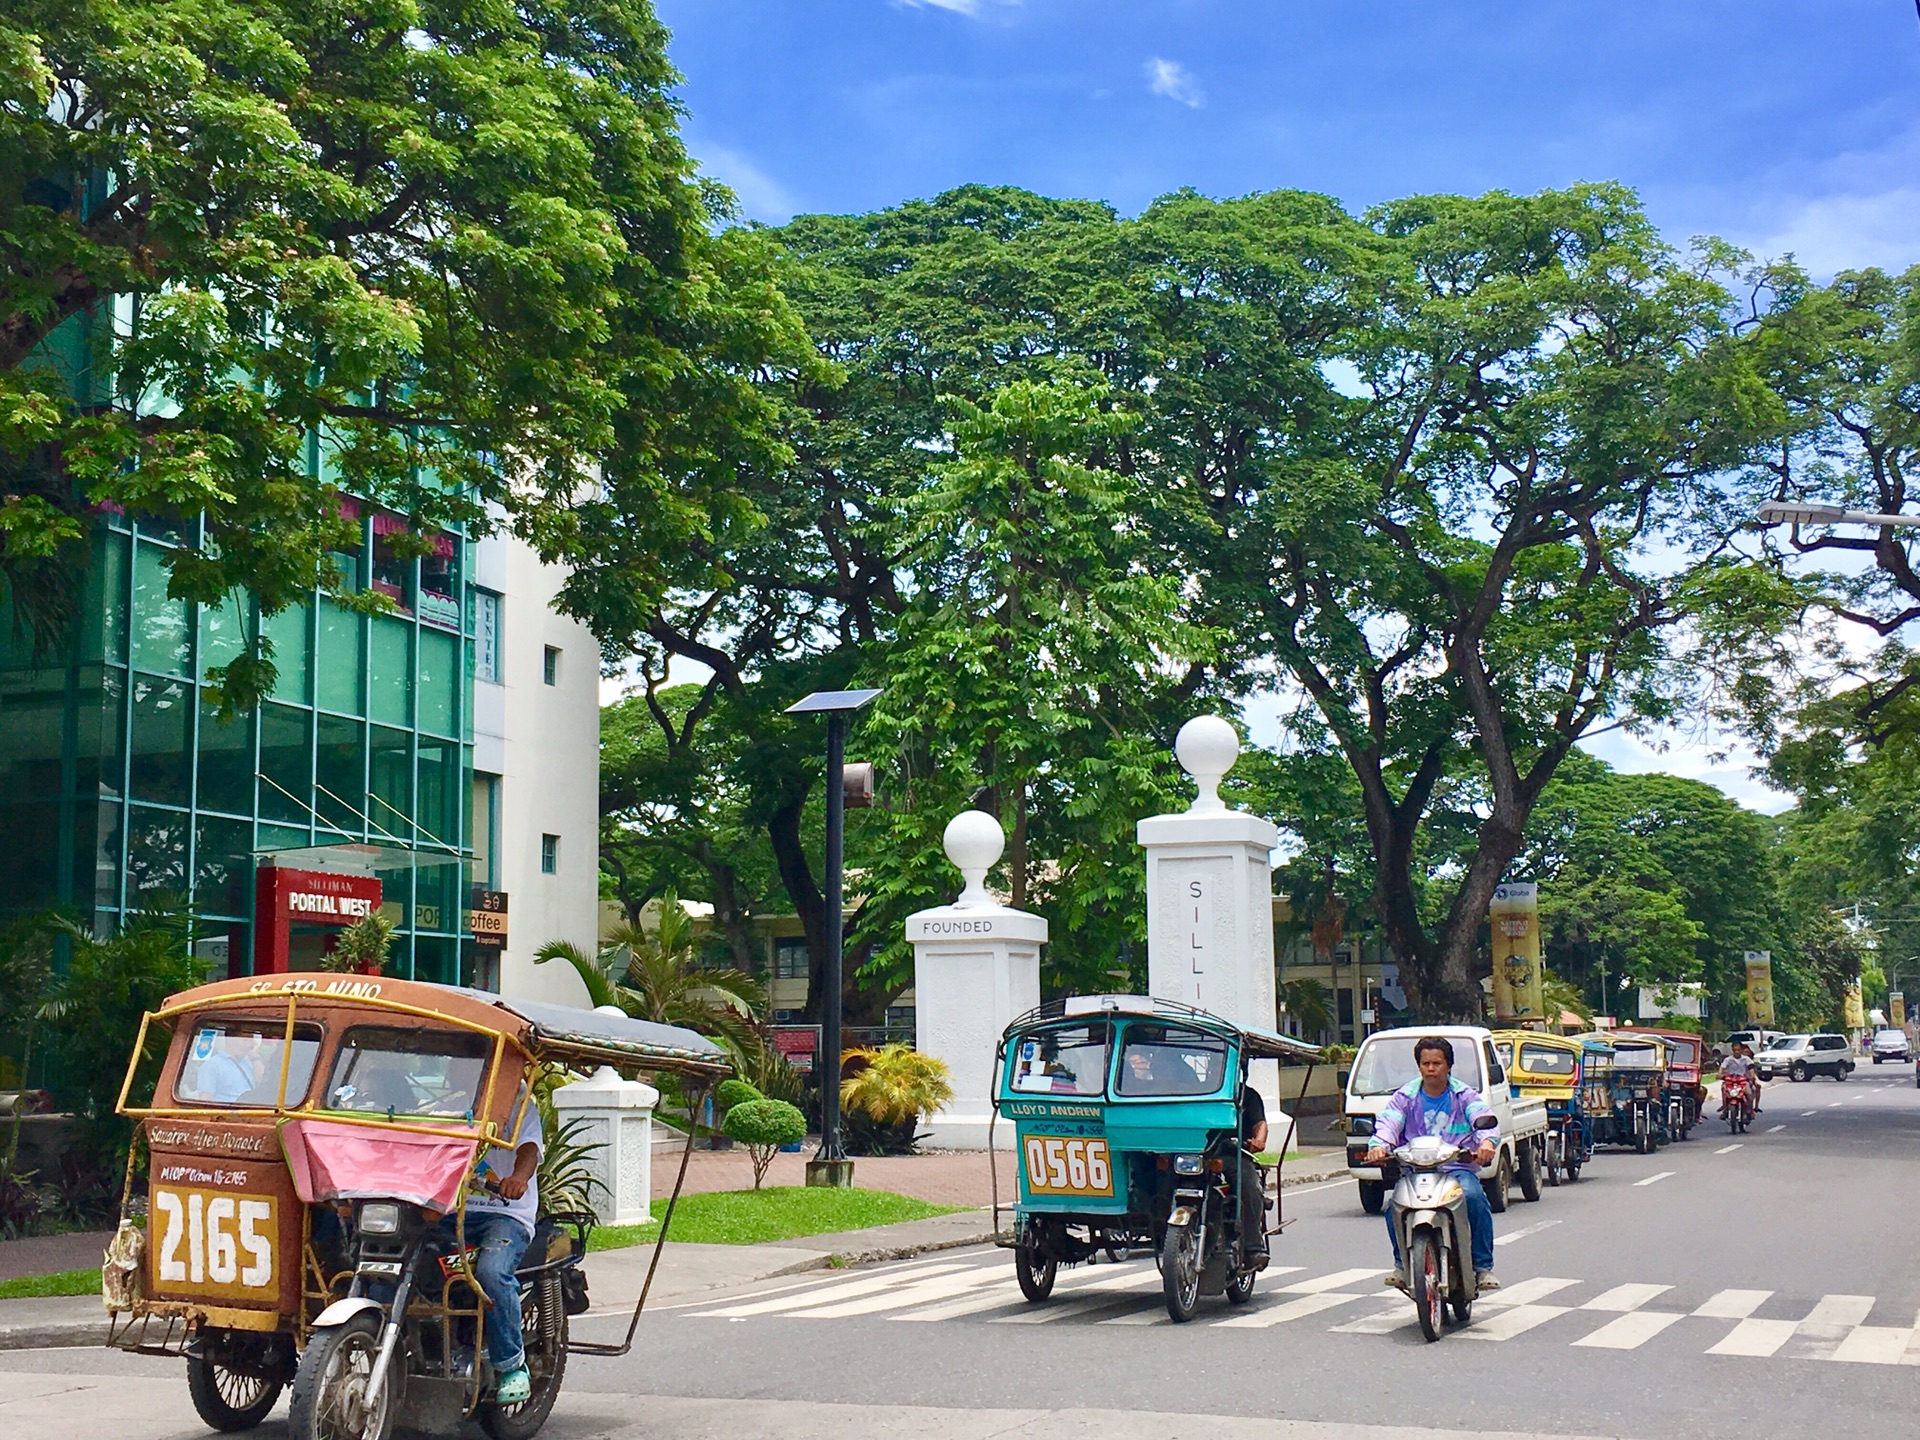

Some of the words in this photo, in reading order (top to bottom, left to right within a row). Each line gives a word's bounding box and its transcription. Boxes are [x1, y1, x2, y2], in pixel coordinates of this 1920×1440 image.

[289, 891, 338, 914] PORTAL
[338, 896, 372, 917] WEST
[463, 913, 500, 930] coffee
[923, 920, 993, 935] FOUNDED
[1010, 1104, 1047, 1115] LLOYD
[1050, 1105, 1100, 1117] ANDREW
[1026, 1138, 1111, 1190] 0566
[156, 1190, 273, 1288] 2165
